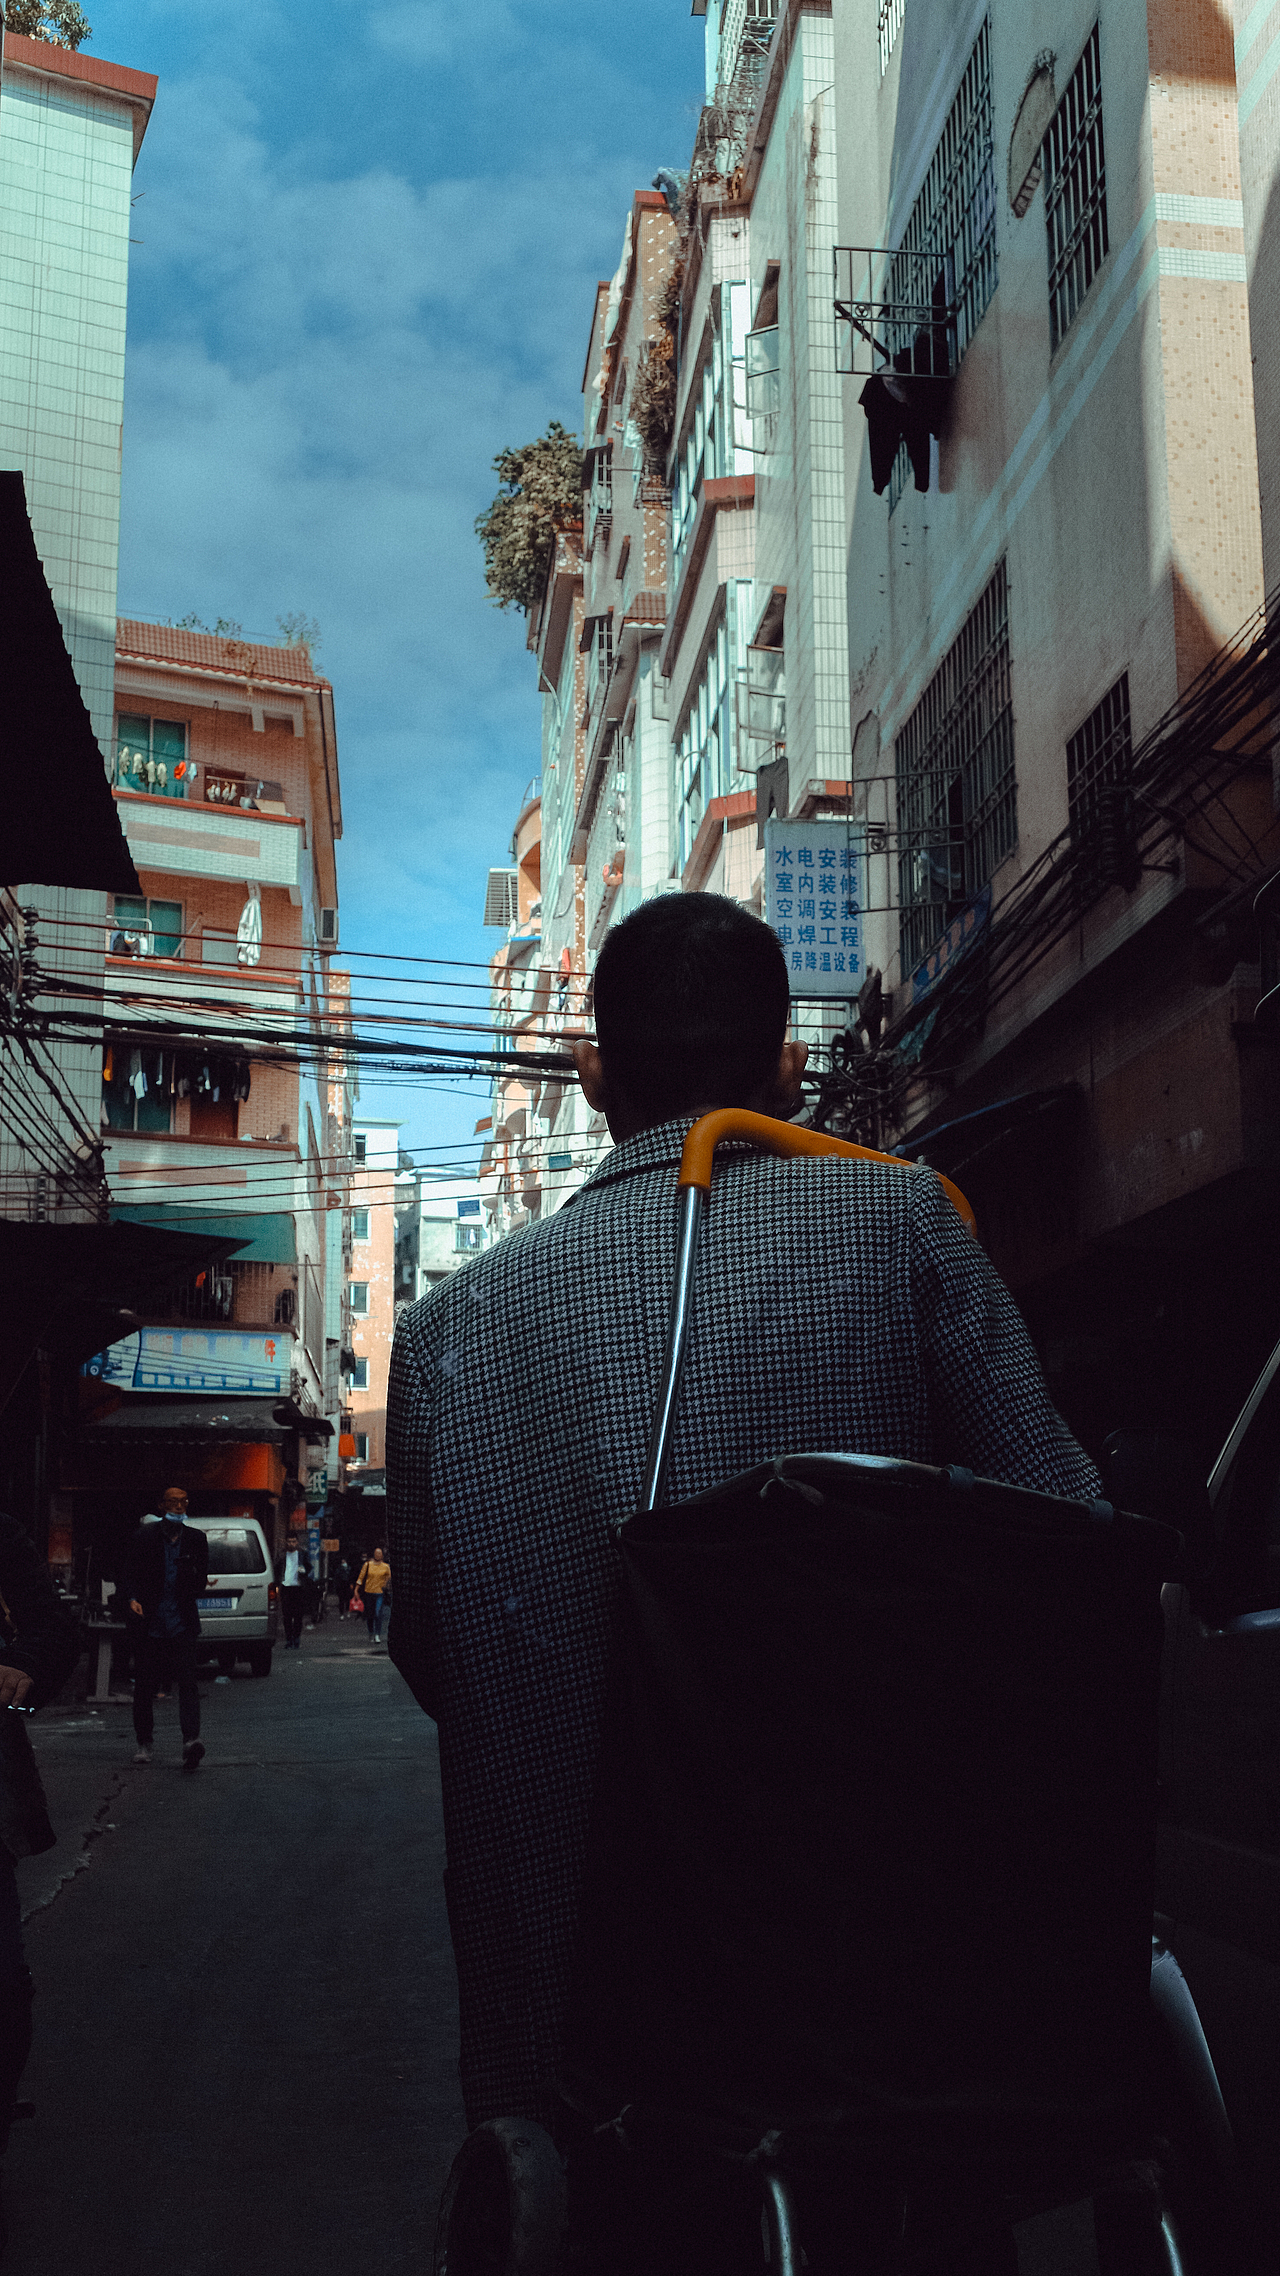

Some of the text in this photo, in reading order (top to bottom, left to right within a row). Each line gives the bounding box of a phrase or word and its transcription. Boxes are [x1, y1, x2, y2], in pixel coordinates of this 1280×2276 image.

[775, 846, 858, 869] 水电安装
[775, 871, 859, 895] 室内装修
[776, 898, 859, 921] 空调安装
[777, 924, 859, 947] 电焊工程
[783, 951, 860, 974] 房降温设备
